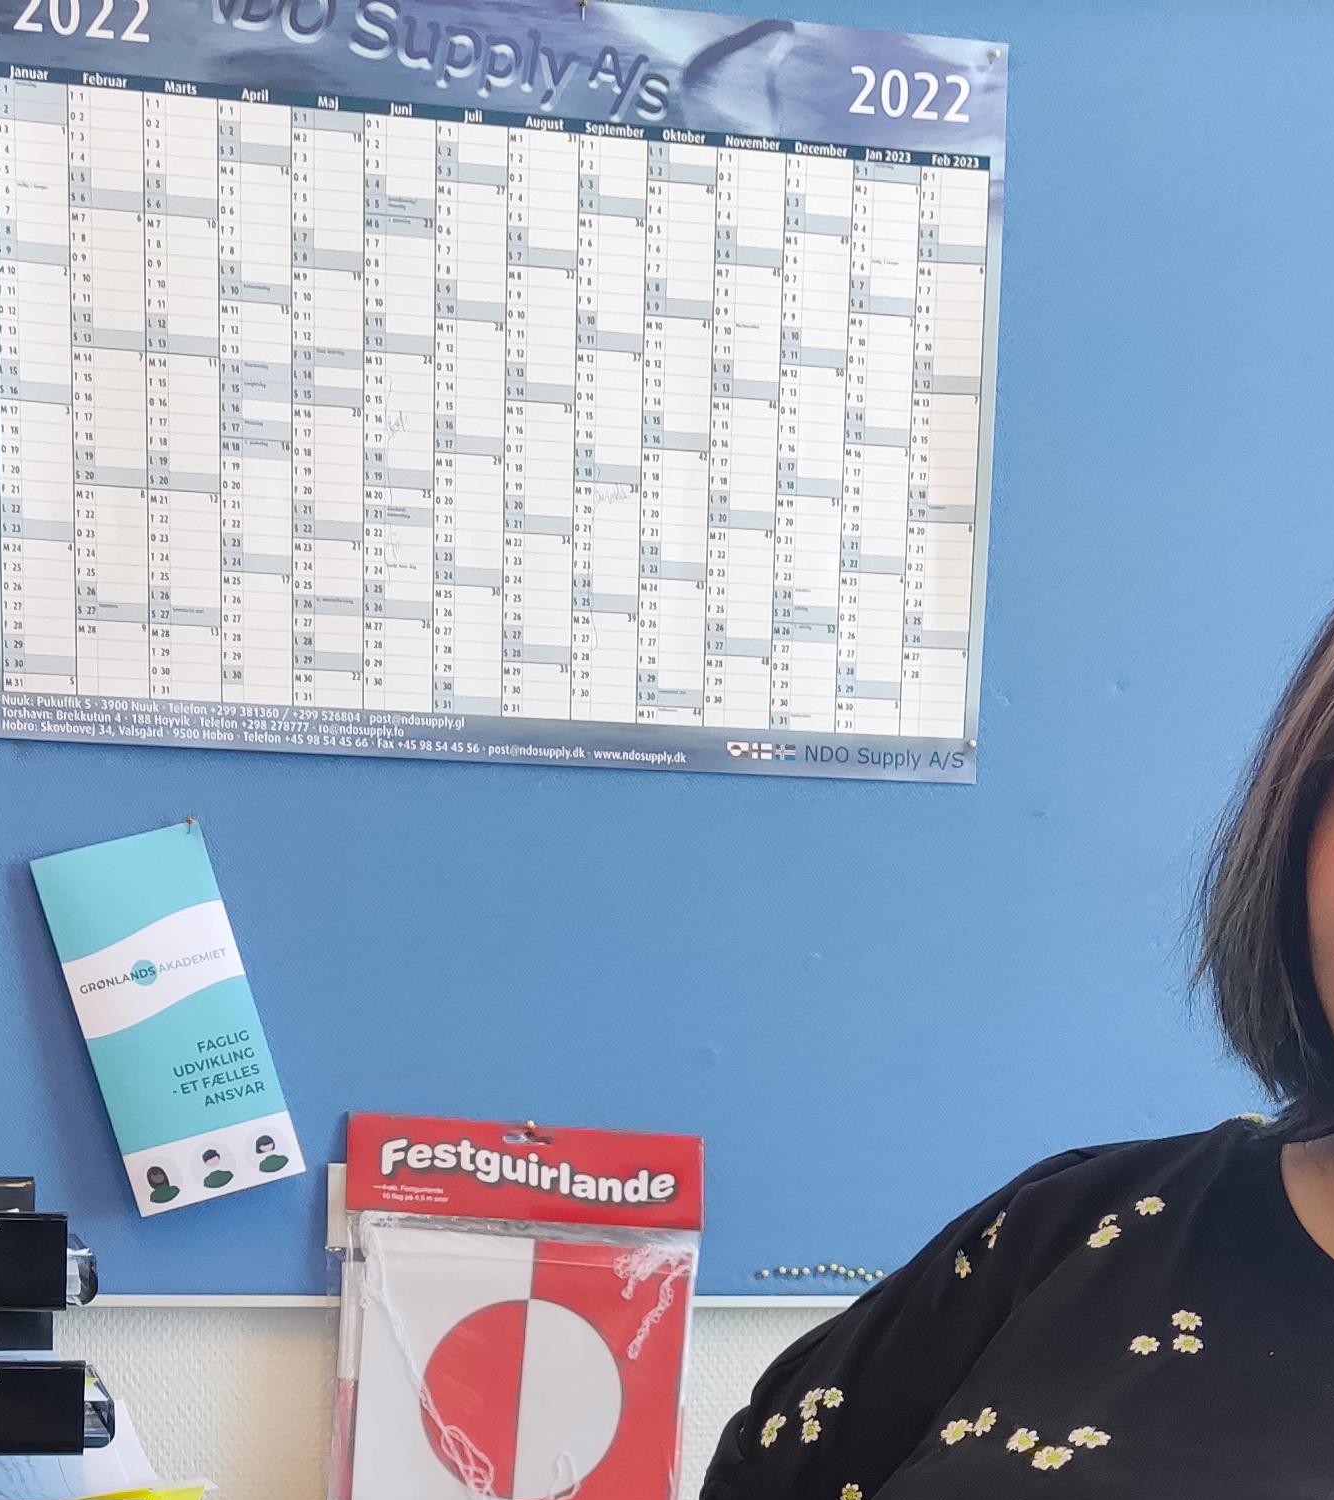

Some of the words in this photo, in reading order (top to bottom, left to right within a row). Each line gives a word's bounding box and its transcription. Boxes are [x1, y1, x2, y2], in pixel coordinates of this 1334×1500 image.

[13, 0, 150, 43] 2022
[348, 0, 582, 111] Supply
[10, 65, 48, 80] Januar
[83, 73, 127, 88] Februar
[165, 81, 197, 95] Marts
[241, 88, 268, 103] April
[849, 65, 970, 123] 2022
[318, 96, 338, 110] Maj
[390, 103, 412, 116] Juni
[464, 110, 482, 124] Juli
[525, 116, 565, 131] August
[585, 122, 645, 139] September
[662, 131, 706, 144] Oktober
[725, 135, 780, 151] November
[795, 142, 847, 158] December
[865, 149, 882, 162] Jan
[885, 150, 911, 164] 2023
[931, 155, 951, 167] Feb
[953, 156, 980, 169] 2023
[1, 694, 34, 706] Nuuk:
[37, 697, 81, 709] Pukuffik
[102, 700, 128, 711] 3900
[131, 702, 159, 713] Nuuk
[169, 703, 207, 714] Telefon
[211, 706, 236, 717] +299
[240, 707, 279, 718] 381360
[293, 710, 318, 720] +299
[321, 712, 360, 722] 526804
[370, 714, 465, 730] post@ndosupply.gl
[132, 714, 150, 725] 188
[200, 716, 237, 728] Telefon
[241, 720, 267, 730] +298
[271, 720, 309, 731] 278777
[2, 720, 38, 732] Hobro:
[173, 729, 199, 739] 9500
[203, 729, 234, 741] Hobro
[243, 732, 281, 743] Telefon
[285, 734, 304, 744] +45
[307, 735, 319, 745] 98
[324, 735, 336, 746] 54
[339, 736, 352, 747] 45
[355, 737, 368, 748] 66
[378, 738, 394, 749] Fax
[398, 740, 416, 750] +45
[420, 740, 432, 750] 98
[435, 741, 448, 751] 54
[451, 742, 463, 752] 45
[466, 743, 480, 753] 56
[488, 744, 585, 760] post@ndosupply.dk
[594, 750, 687, 764] www.ndosupply.dk
[805, 745, 849, 763] NDO
[858, 748, 921, 771] Supply
[929, 750, 965, 771] A/S
[197, 1029, 250, 1054] FAGLIG
[172, 1047, 256, 1078] UDVIKLING
[180, 1080, 199, 1096] ET
[202, 1064, 261, 1091] FÆLLES
[203, 1080, 266, 1108] ANSVAR
[381, 1138, 676, 1203] Festguirlande
